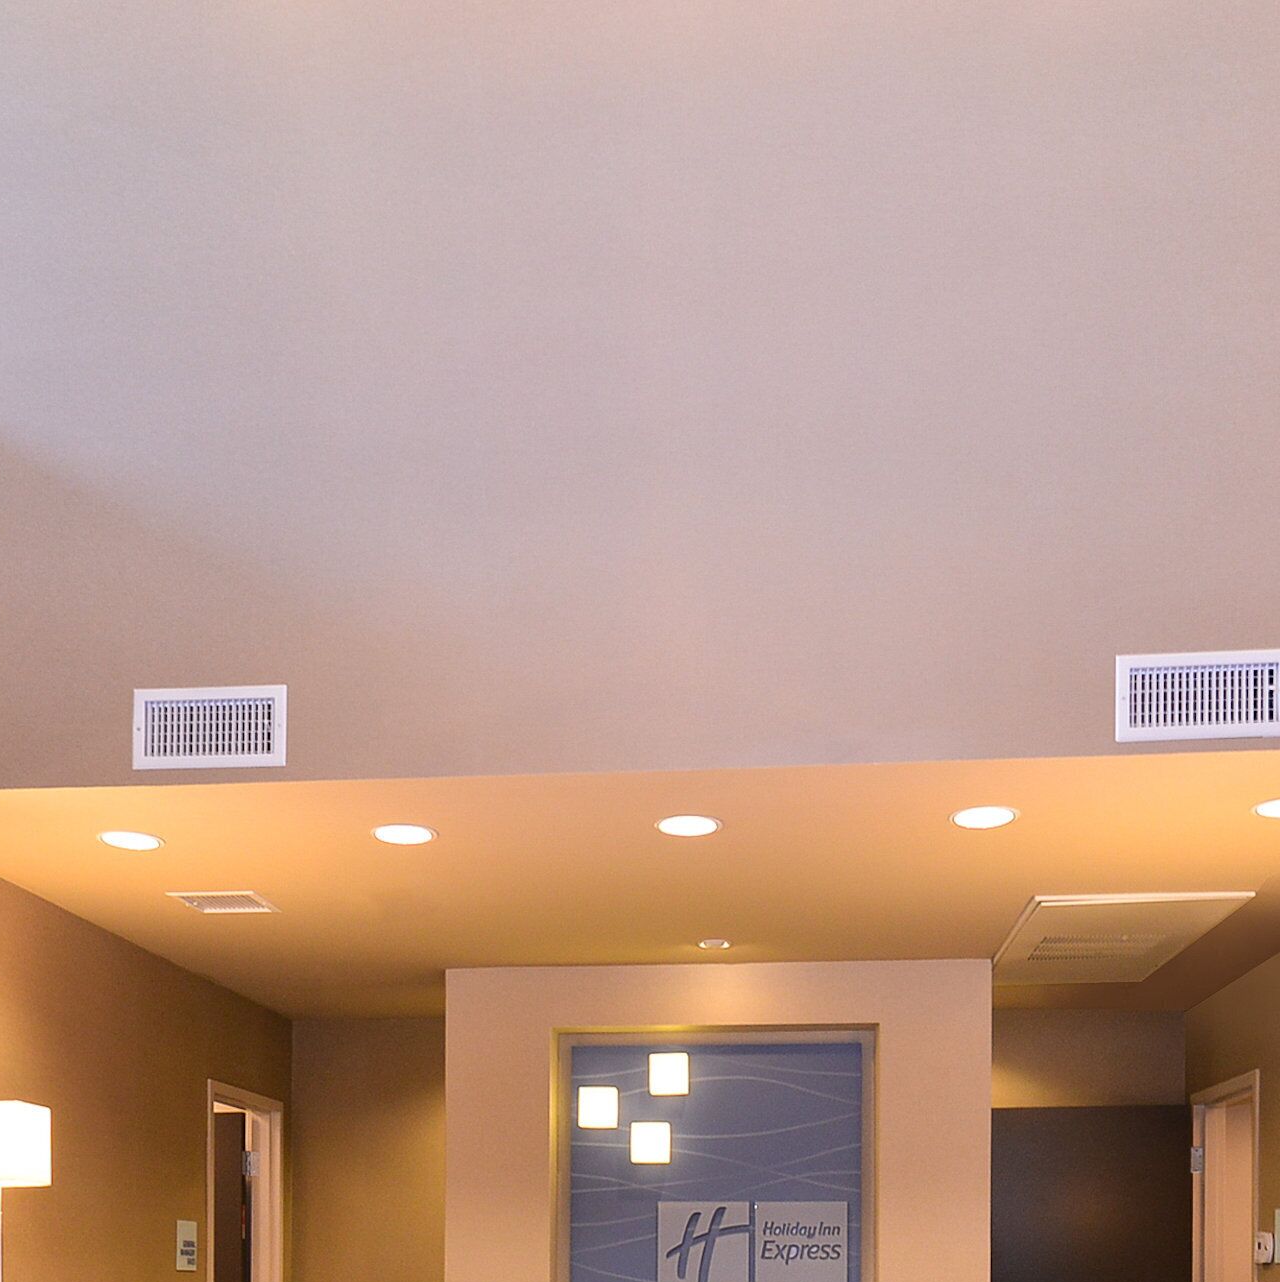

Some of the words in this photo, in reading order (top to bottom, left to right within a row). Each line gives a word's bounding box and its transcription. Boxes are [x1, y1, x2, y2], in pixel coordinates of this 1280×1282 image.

[762, 1221, 816, 1239] Holiday
[818, 1221, 841, 1236] Inn
[760, 1240, 842, 1265] Express
